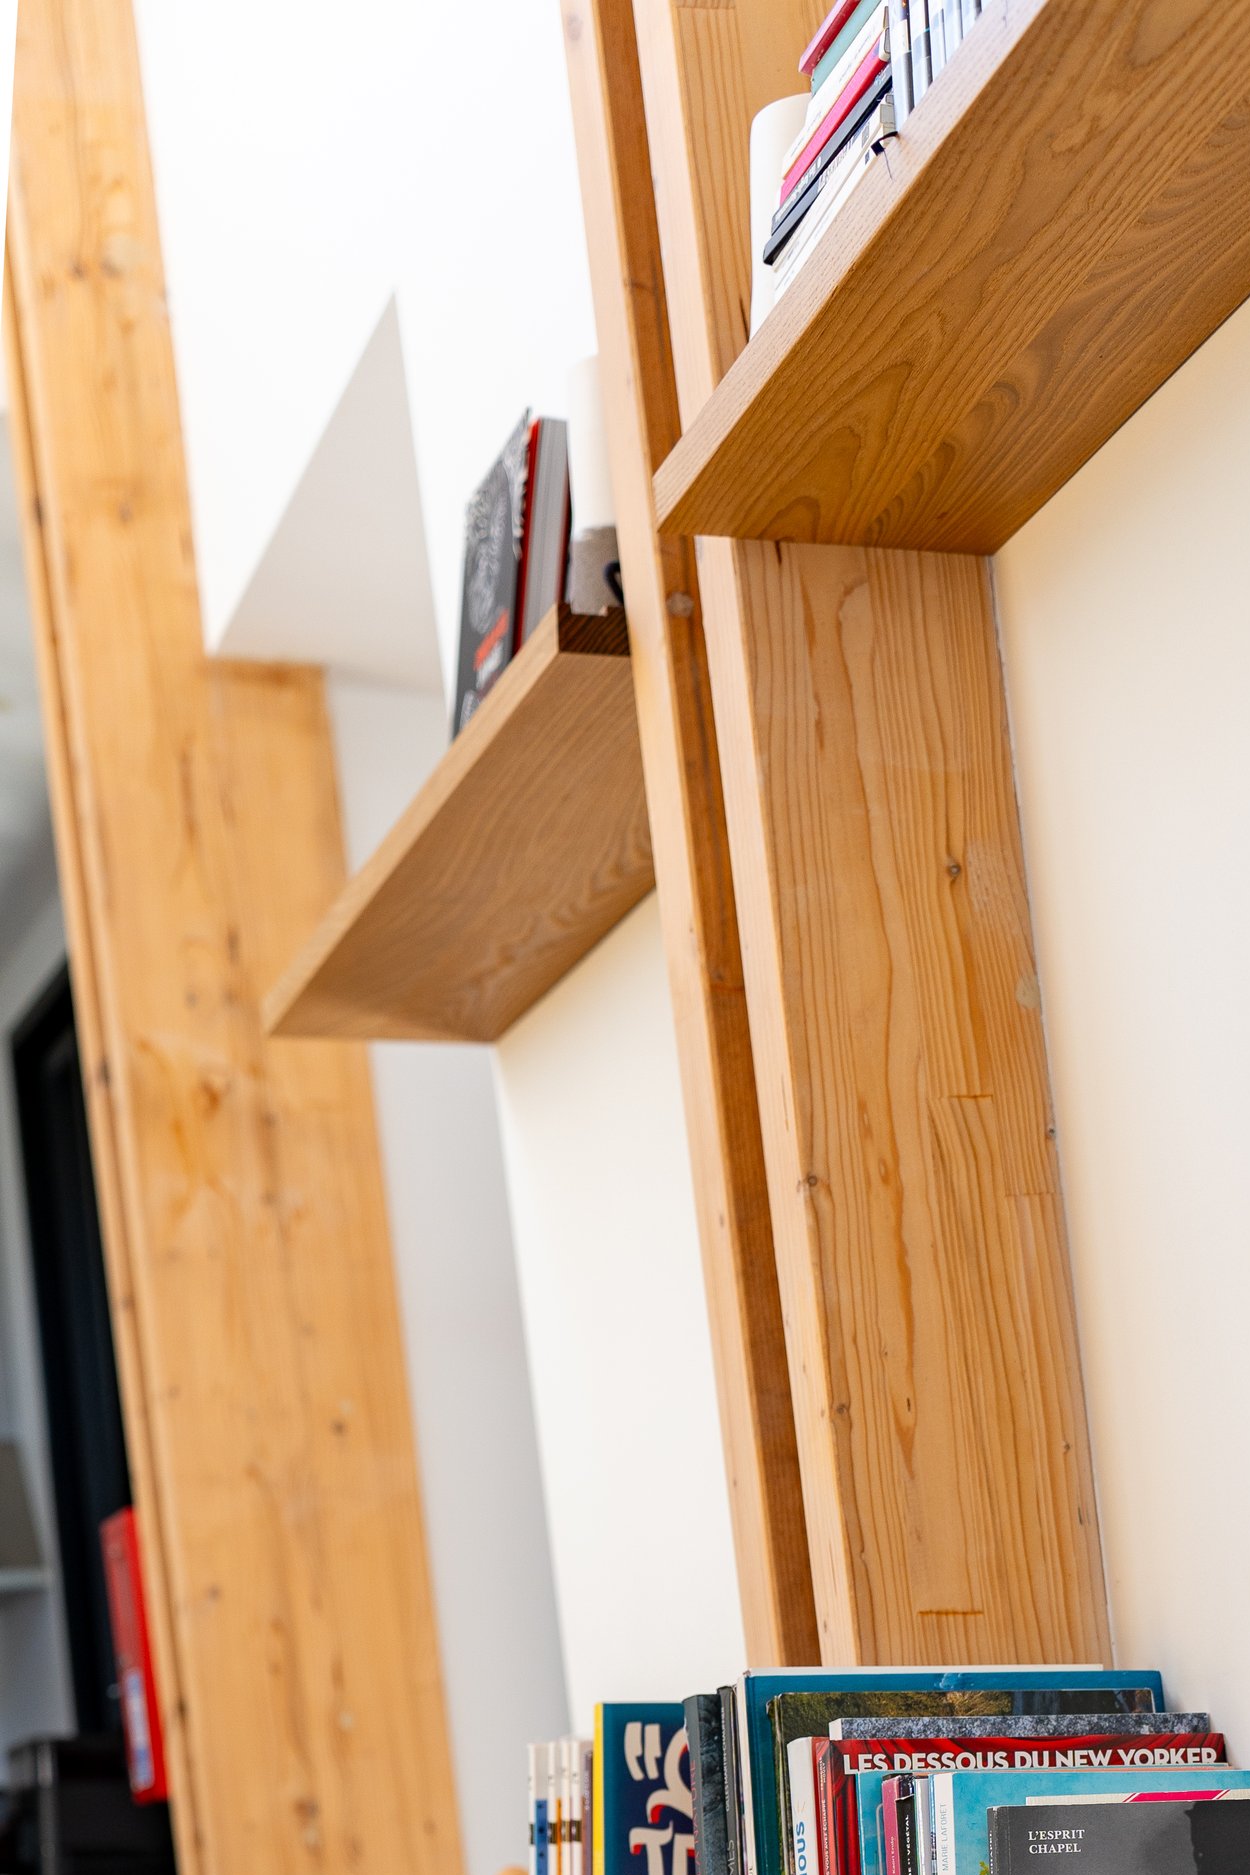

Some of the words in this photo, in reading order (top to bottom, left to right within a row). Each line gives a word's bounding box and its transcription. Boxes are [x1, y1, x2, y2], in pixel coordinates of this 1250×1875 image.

[843, 1754, 891, 1775] LES
[894, 1751, 1008, 1772] DESSOUS
[1014, 1750, 1050, 1769] DU
[1056, 1749, 1113, 1768] NEW
[1115, 1747, 1217, 1767] YORKER
[904, 1814, 912, 1856] VÉGÉTAL
[1028, 1829, 1085, 1841] L'ESPRIT
[1028, 1843, 1082, 1854] CHAPEL
[941, 1844, 949, 1871] MARIE
